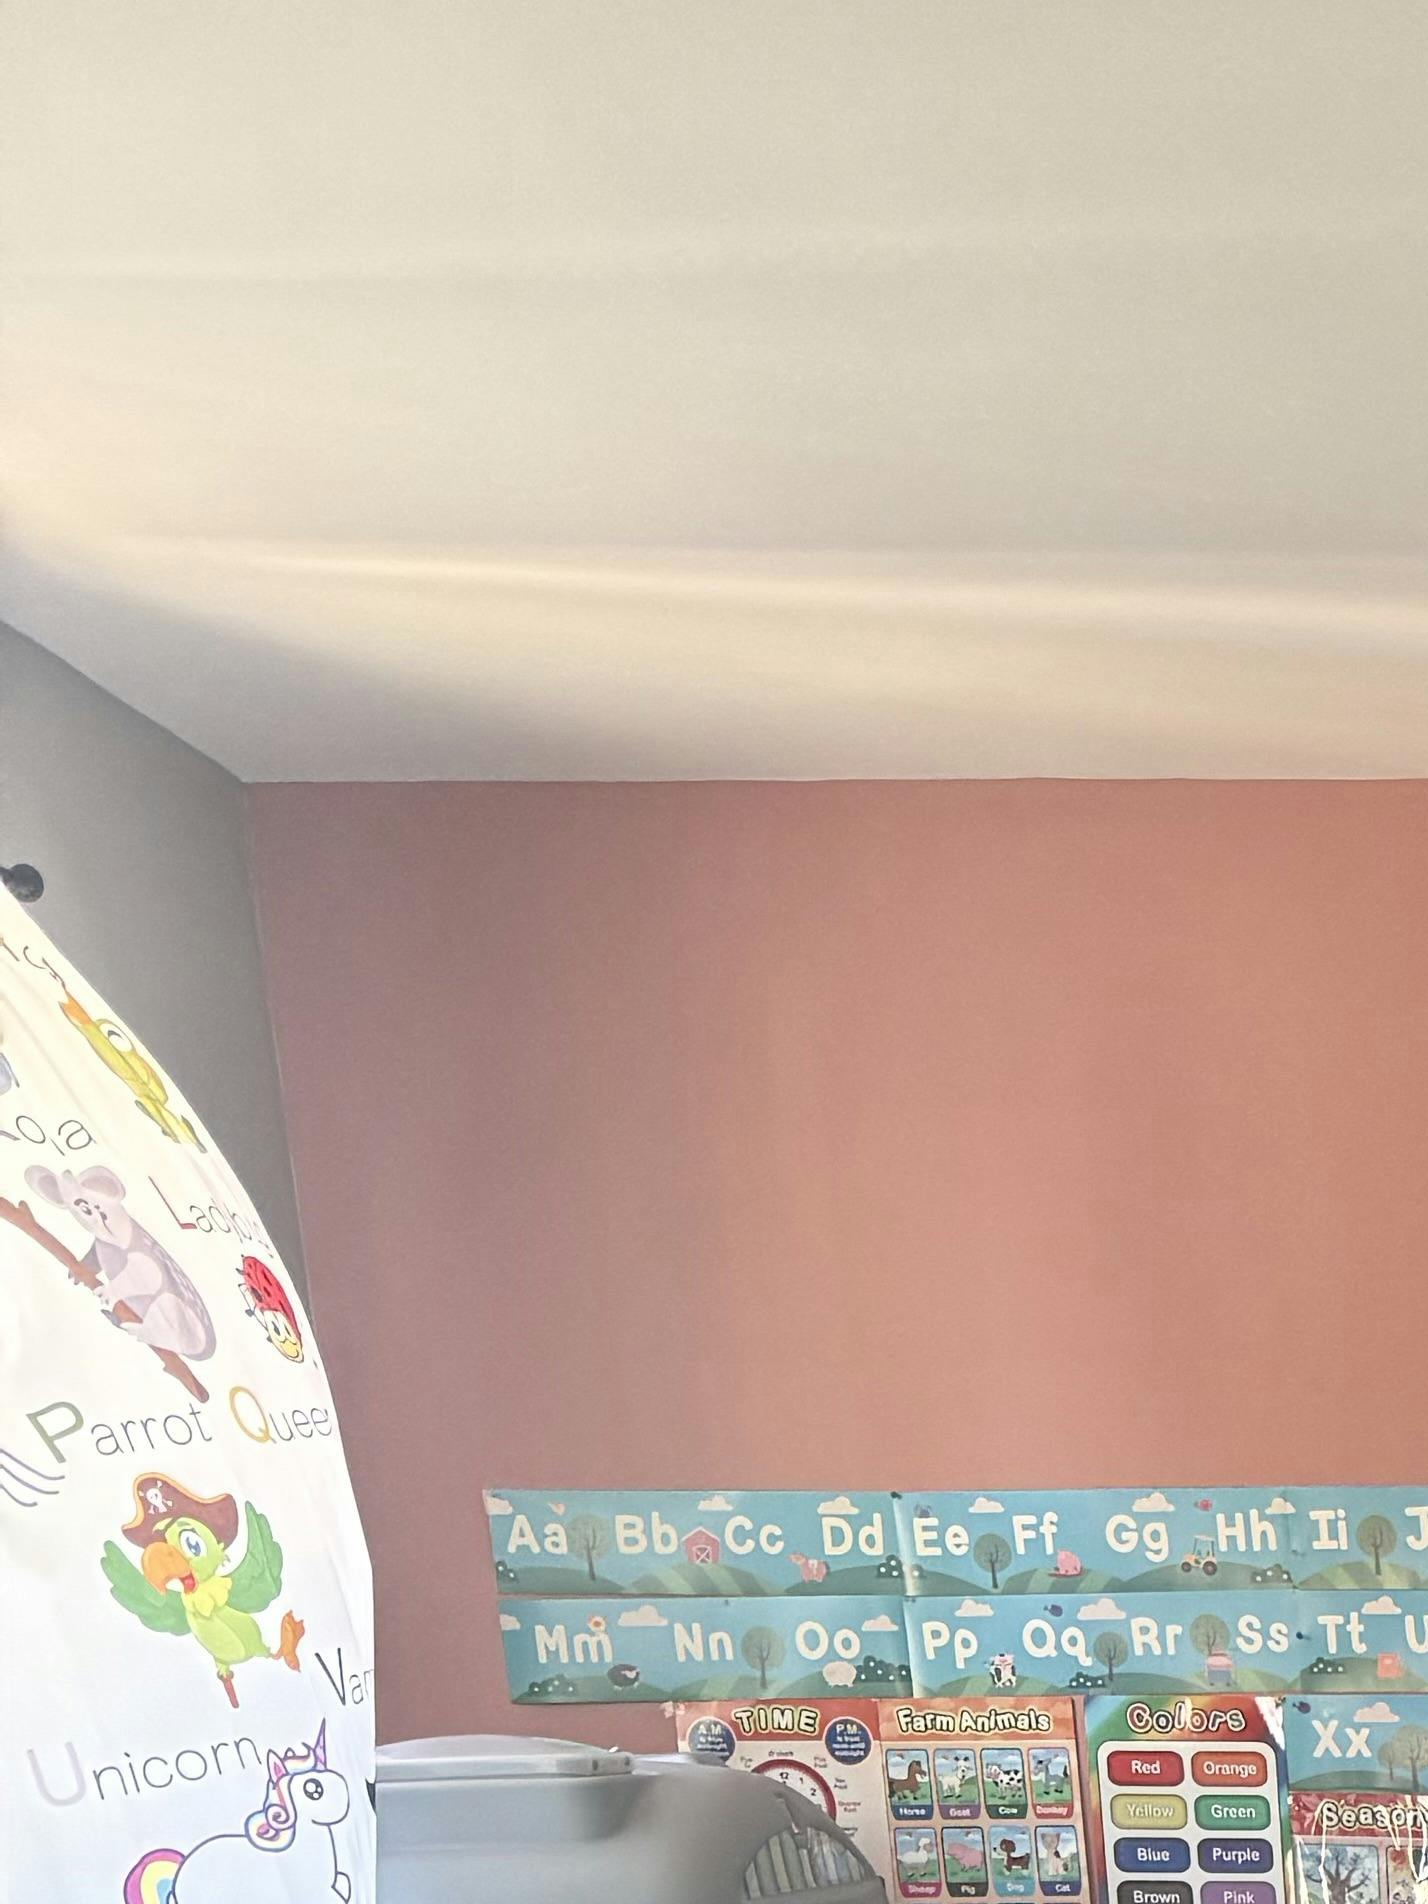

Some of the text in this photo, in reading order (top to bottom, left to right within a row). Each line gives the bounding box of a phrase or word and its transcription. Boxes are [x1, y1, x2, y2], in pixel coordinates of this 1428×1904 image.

[26, 1386, 333, 1464] Parrot Quee
[507, 1514, 568, 1555] Aa
[615, 1512, 678, 1556] Bb
[724, 1515, 785, 1556] Cc
[822, 1513, 885, 1557] Dd
[913, 1516, 970, 1556] Ee
[1012, 1511, 1058, 1556] Ff
[1105, 1511, 1169, 1563] Gg
[1216, 1508, 1278, 1553] Hh
[1311, 1509, 1349, 1552] Ii
[534, 1624, 614, 1664] Mm
[674, 1622, 734, 1663] Nn
[794, 1620, 861, 1662] Oo
[922, 1621, 980, 1670] Pp
[1022, 1619, 1093, 1667] Qq
[1131, 1616, 1183, 1657] Rr
[1235, 1614, 1289, 1656] Ss
[1317, 1615, 1367, 1655] Tt
[734, 1706, 821, 1735] TIME
[896, 1707, 1052, 1737] Farm Animals
[1127, 1702, 1247, 1734] Colors
[1312, 1719, 1372, 1759] Xx
[27, 1736, 263, 1808] Unicorn
[1131, 1760, 1161, 1775] Red
[1203, 1761, 1258, 1777] Orange
[1126, 1804, 1175, 1819] Yellow
[1210, 1804, 1256, 1820] Green
[1136, 1847, 1170, 1863] Blue
[1212, 1848, 1261, 1865] Purple
[1223, 1889, 1256, 1904] Pink
